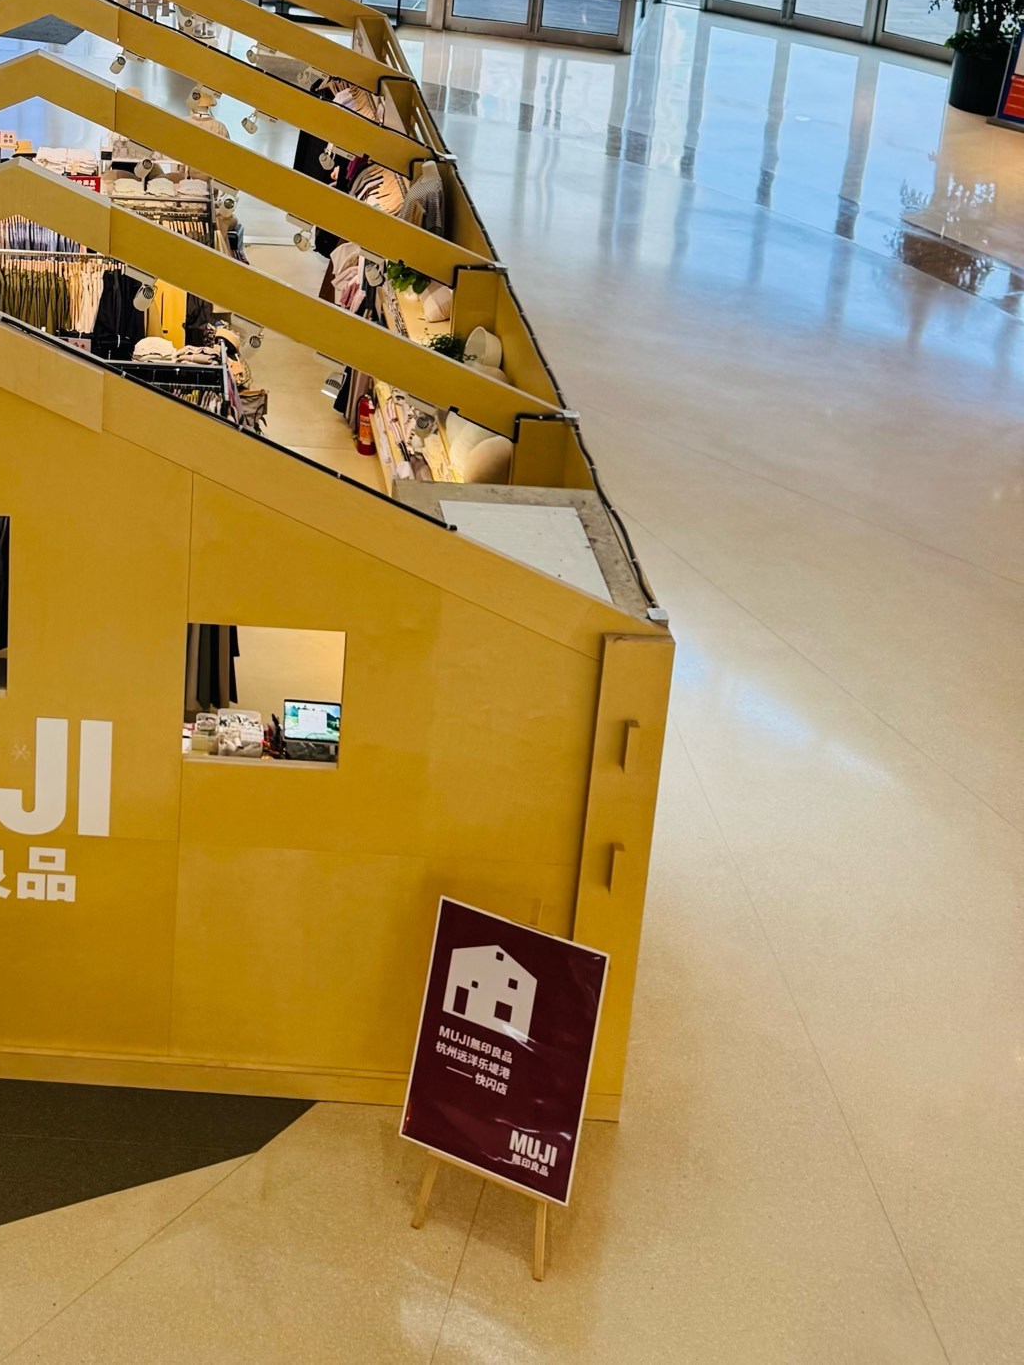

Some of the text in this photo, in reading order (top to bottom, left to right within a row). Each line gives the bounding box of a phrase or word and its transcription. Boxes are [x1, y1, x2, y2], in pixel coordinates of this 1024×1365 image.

[435, 1040, 511, 1080] 杭州远洋乐堤港
[509, 1130, 557, 1167] MUJI
[511, 1153, 549, 1177] 無印良品
